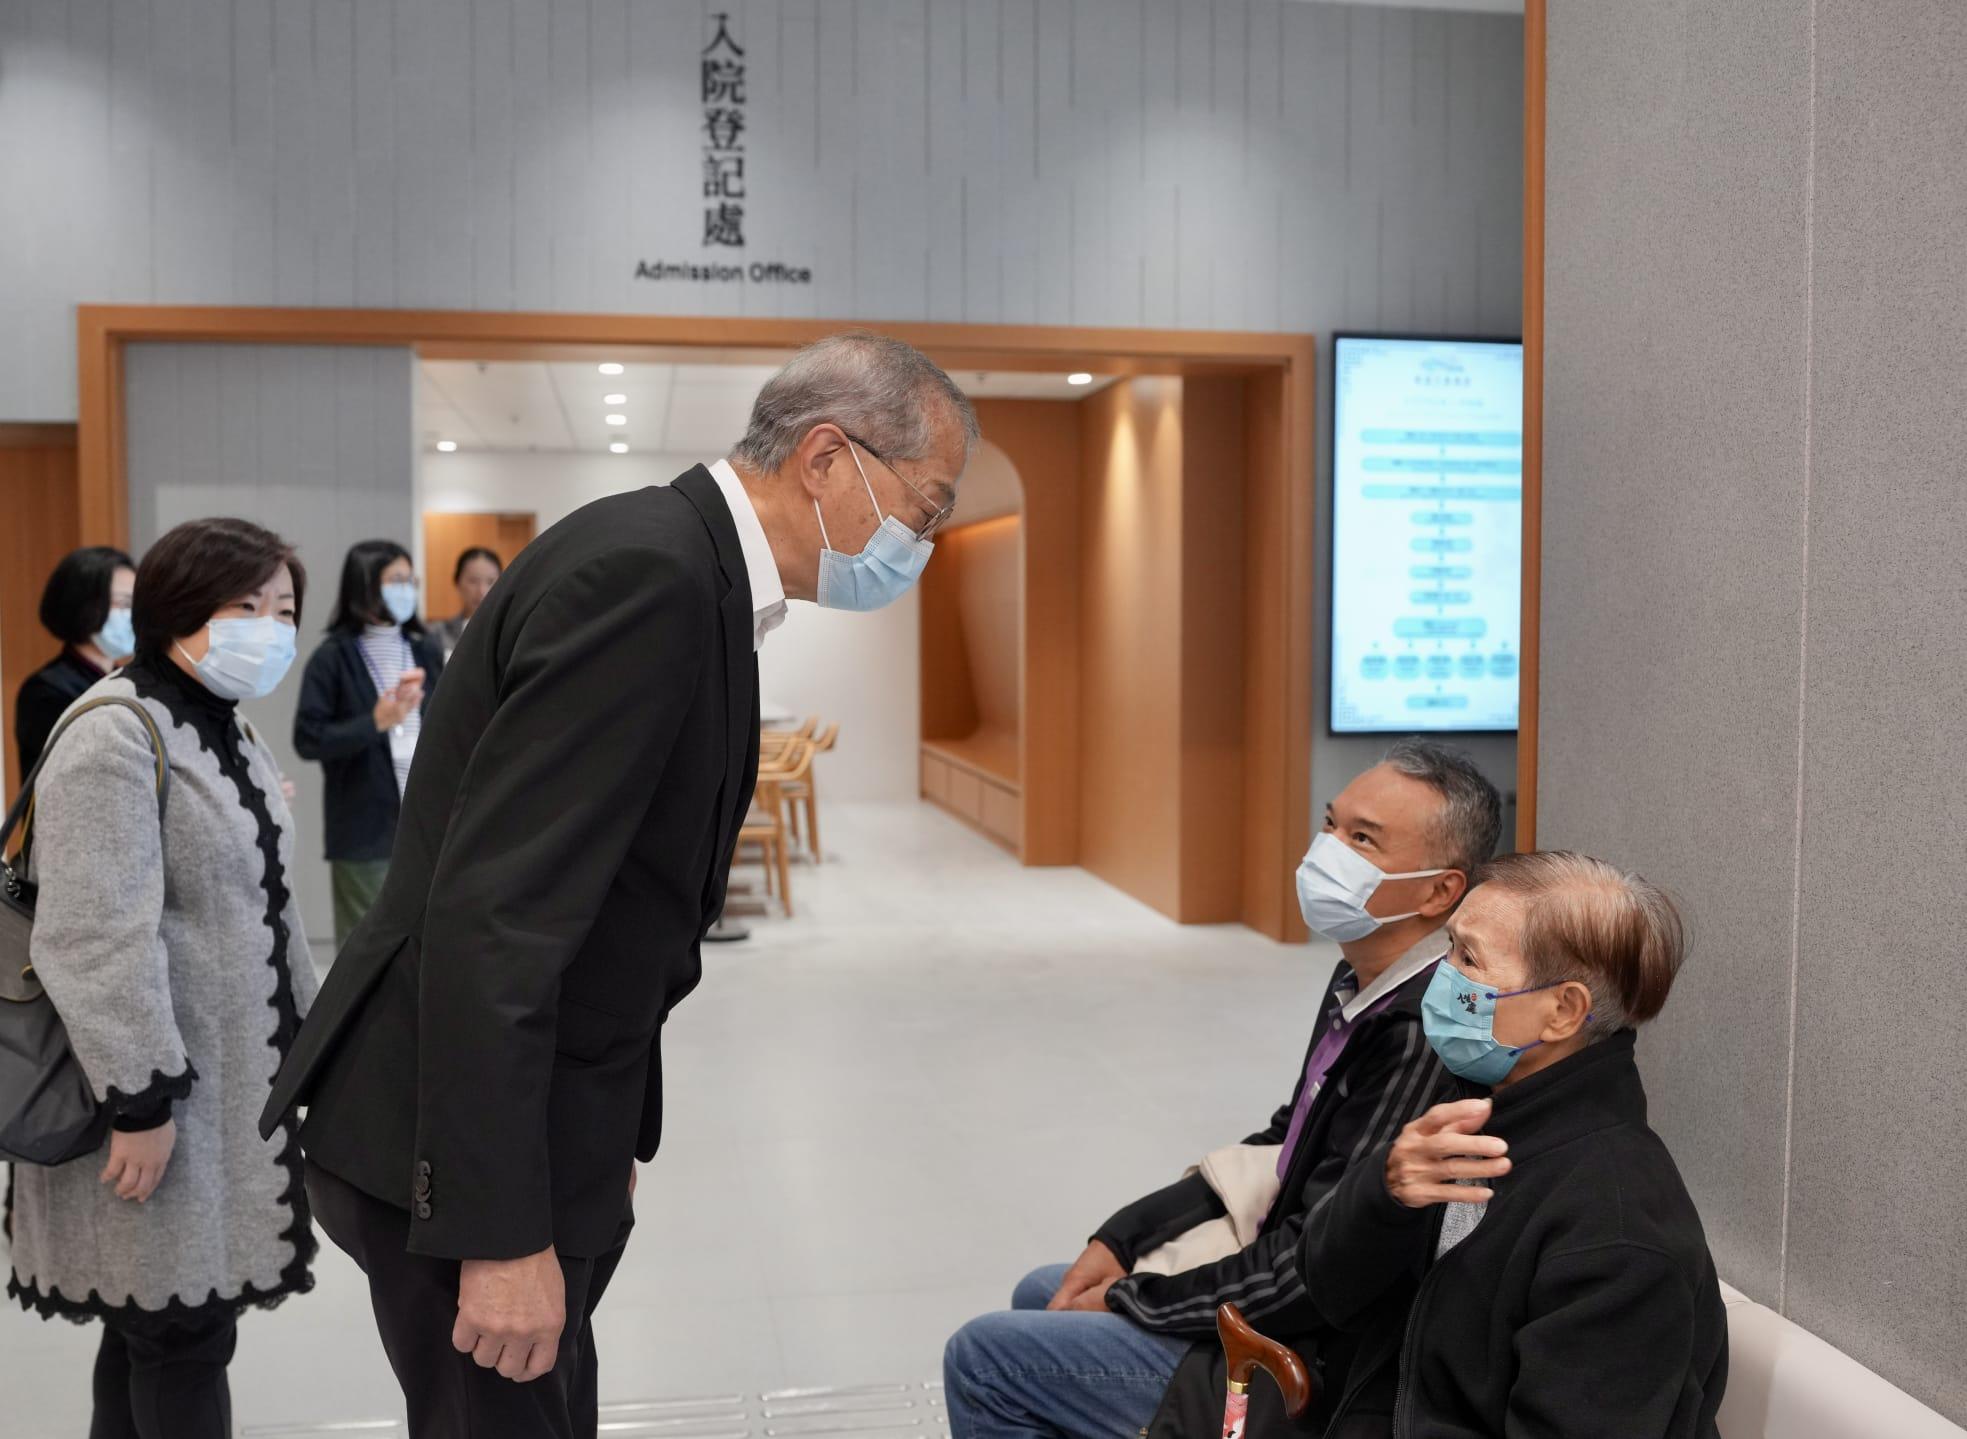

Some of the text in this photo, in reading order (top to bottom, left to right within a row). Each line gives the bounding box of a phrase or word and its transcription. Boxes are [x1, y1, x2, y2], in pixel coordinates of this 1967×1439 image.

[701, 12, 745, 247] 入院登記處
[636, 260, 811, 283] Admission Office
